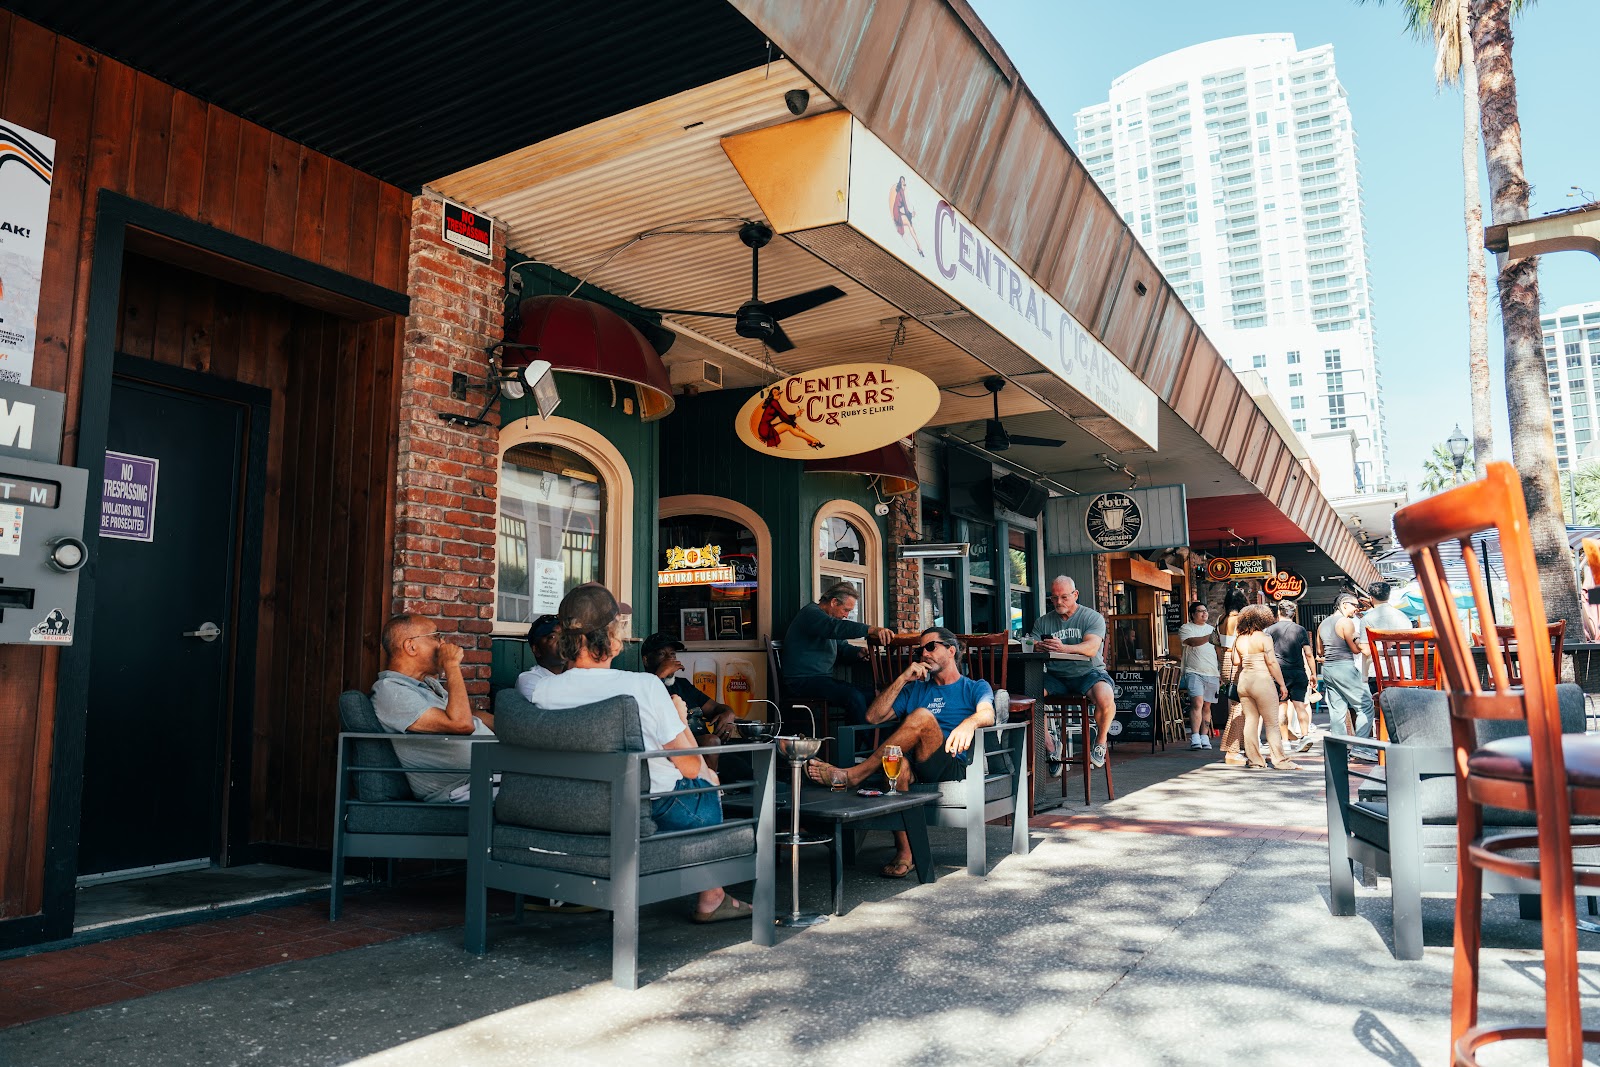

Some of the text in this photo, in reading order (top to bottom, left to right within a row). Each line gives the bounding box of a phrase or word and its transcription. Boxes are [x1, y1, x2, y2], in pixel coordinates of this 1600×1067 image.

[461, 210, 475, 226] NO
[446, 216, 489, 245] TRESPASSING
[934, 199, 1120, 396] CENTRAL CIGARS
[785, 369, 895, 405] CENTRAL
[806, 387, 895, 423] CIGARS
[825, 411, 841, 427] &
[869, 405, 895, 415] ELIXIR
[121, 463, 133, 482] NO
[103, 478, 148, 502] TRESPASSING
[102, 501, 145, 518] VIOLATORS WILL
[1097, 498, 1131, 509] POUR
[101, 514, 145, 531] BE PROSECUTED
[1234, 560, 1263, 568] SAIGON
[1234, 566, 1264, 574] BLONDE
[658, 568, 730, 585] ARTURO FUENTE
[1265, 577, 1303, 593] Crafty
[32, 628, 72, 637] GORILLA
